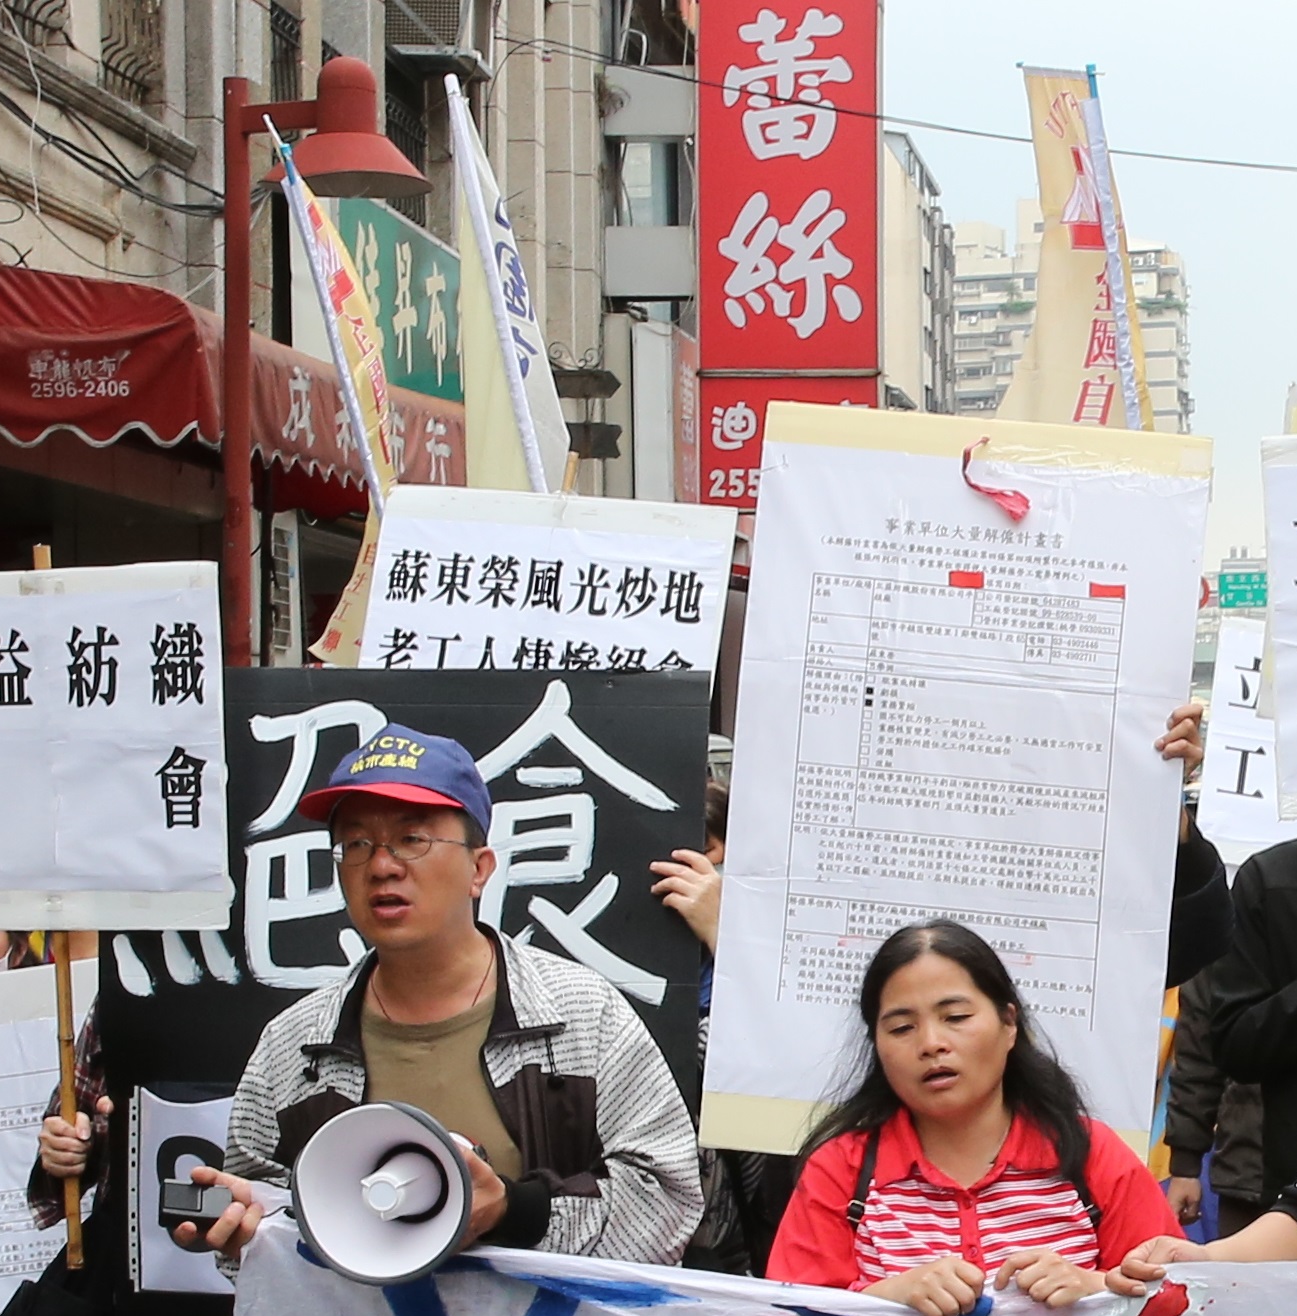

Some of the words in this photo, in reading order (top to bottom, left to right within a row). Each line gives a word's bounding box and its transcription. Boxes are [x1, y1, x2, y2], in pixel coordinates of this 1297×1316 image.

[718, 7, 863, 338] 蕾絲
[30, 380, 131, 398] 2596-2406
[711, 402, 757, 450] 迪
[385, 548, 706, 625] 蘇東榮風光炒地
[363, 735, 427, 758] YCTU
